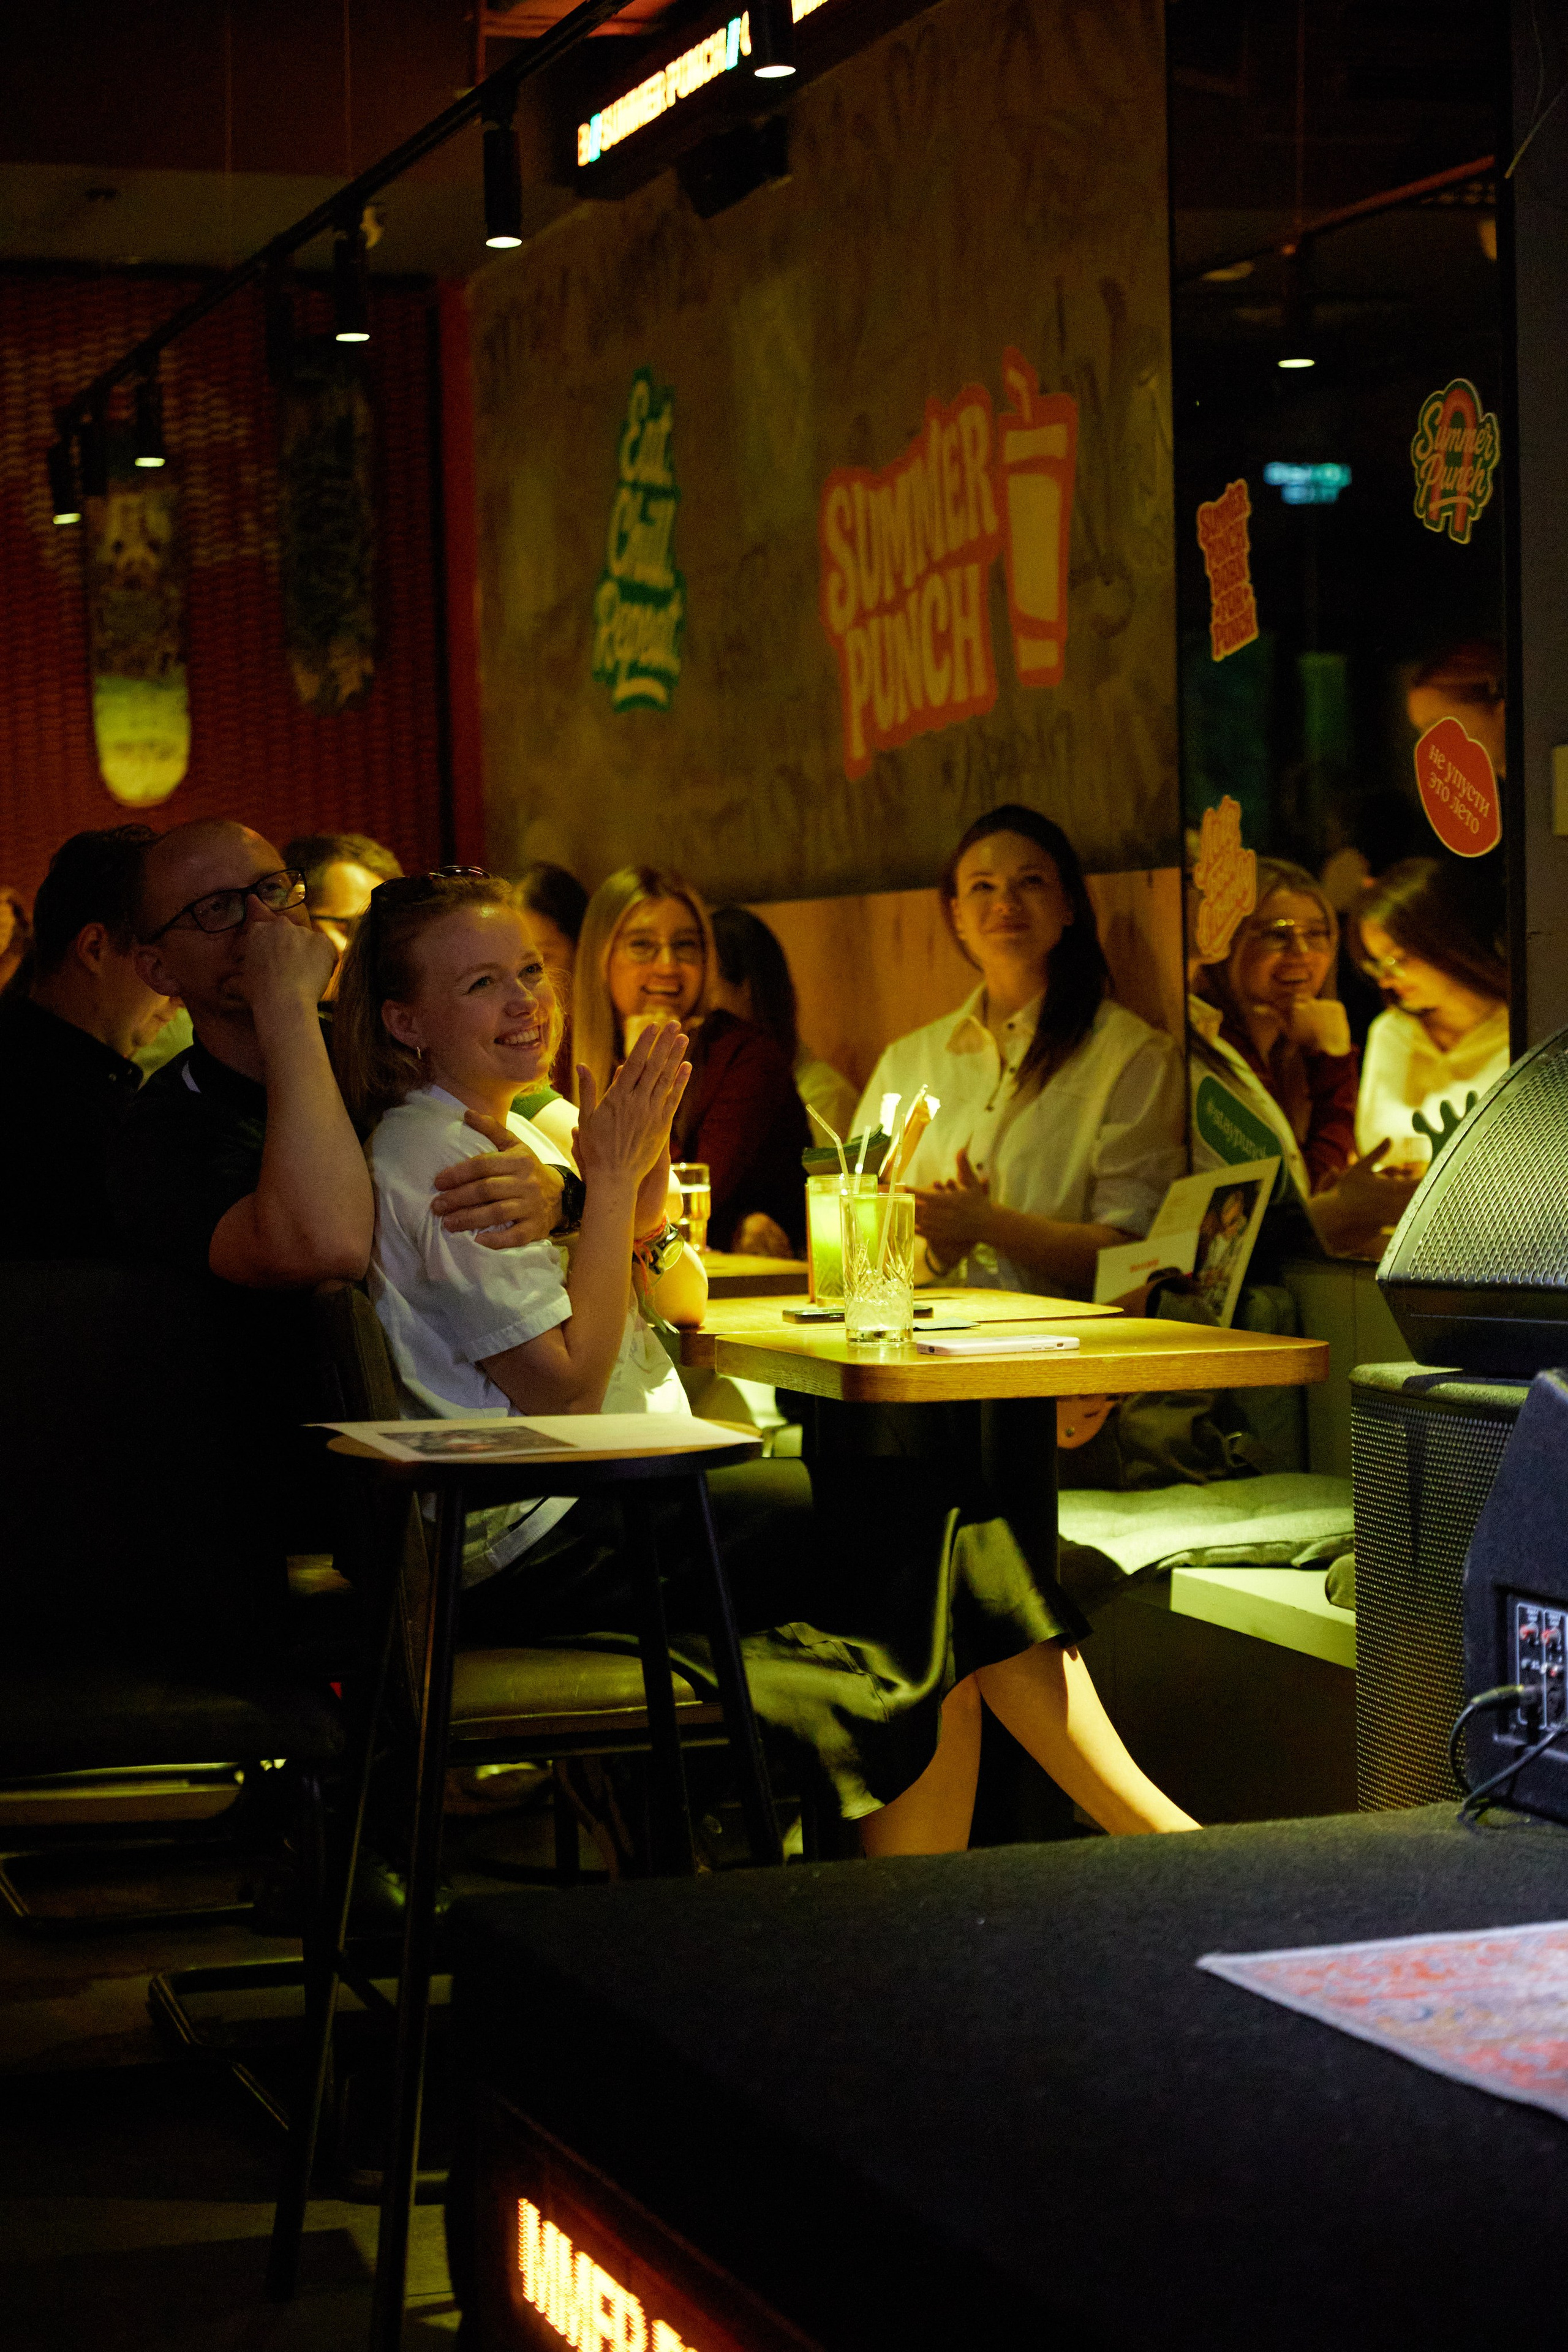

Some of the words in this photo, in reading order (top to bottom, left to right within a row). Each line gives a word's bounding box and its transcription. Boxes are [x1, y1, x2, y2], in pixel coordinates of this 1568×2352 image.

[1415, 400, 1494, 461] Summer
[1419, 452, 1486, 508] Punch
[824, 403, 998, 636] SUMMER
[845, 562, 988, 760] PUNCH
[1427, 771, 1450, 803] это
[1449, 796, 1480, 834] лето
[1428, 744, 1446, 770] не
[1444, 761, 1491, 818] упусти
